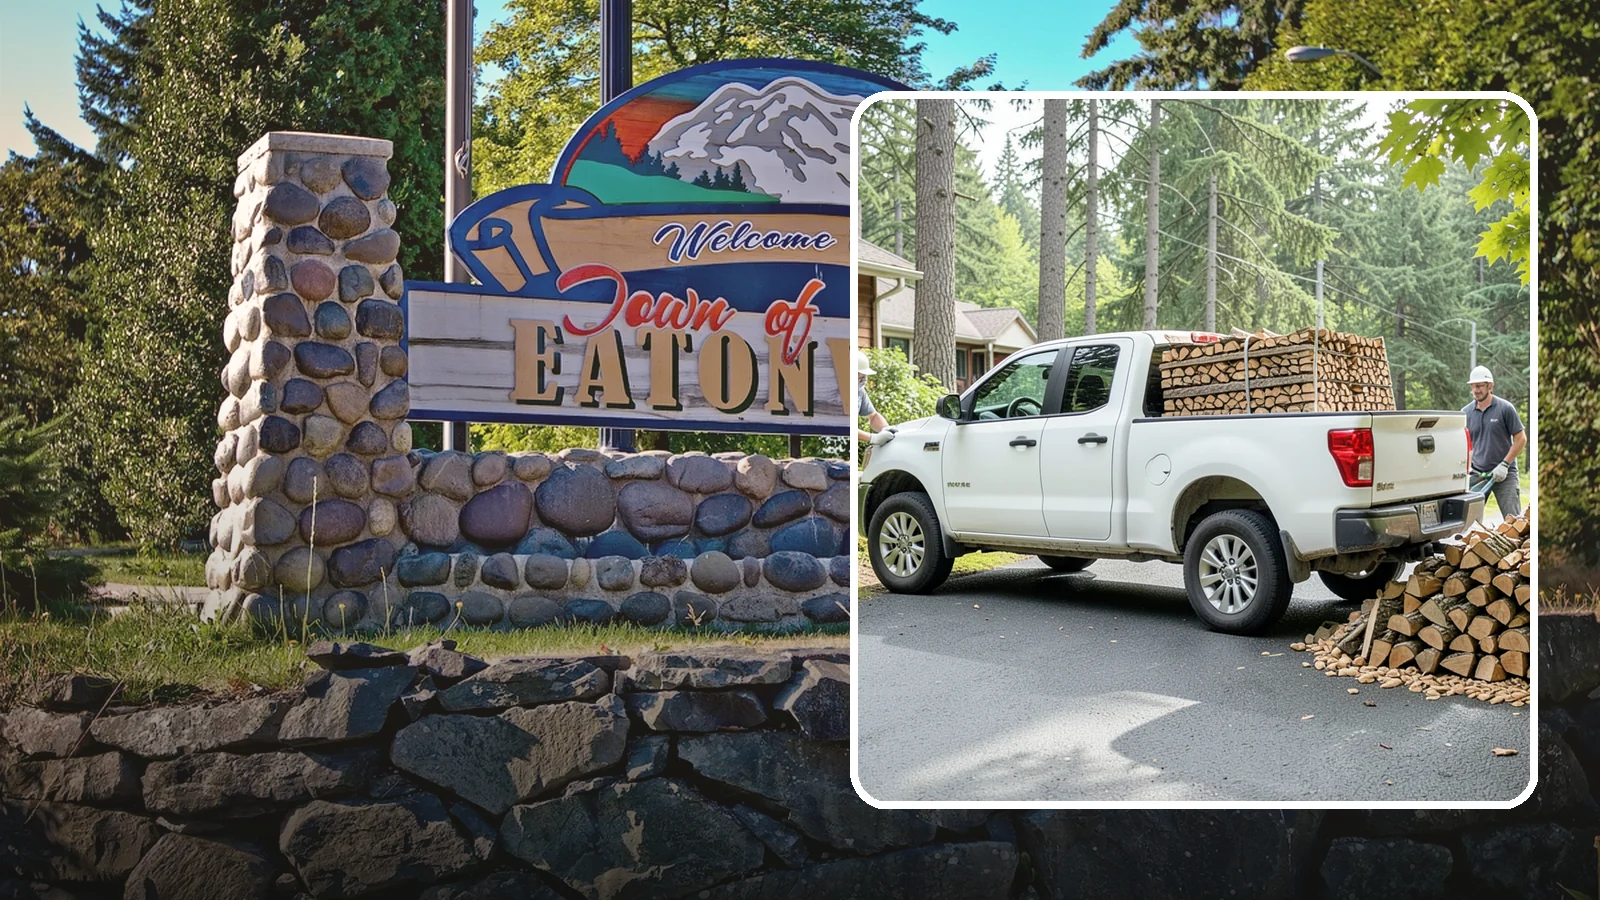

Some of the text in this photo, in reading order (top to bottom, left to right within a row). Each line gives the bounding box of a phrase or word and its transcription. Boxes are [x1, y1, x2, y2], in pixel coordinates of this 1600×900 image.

[653, 220, 836, 262] Welcome
[557, 264, 825, 365] Town of
